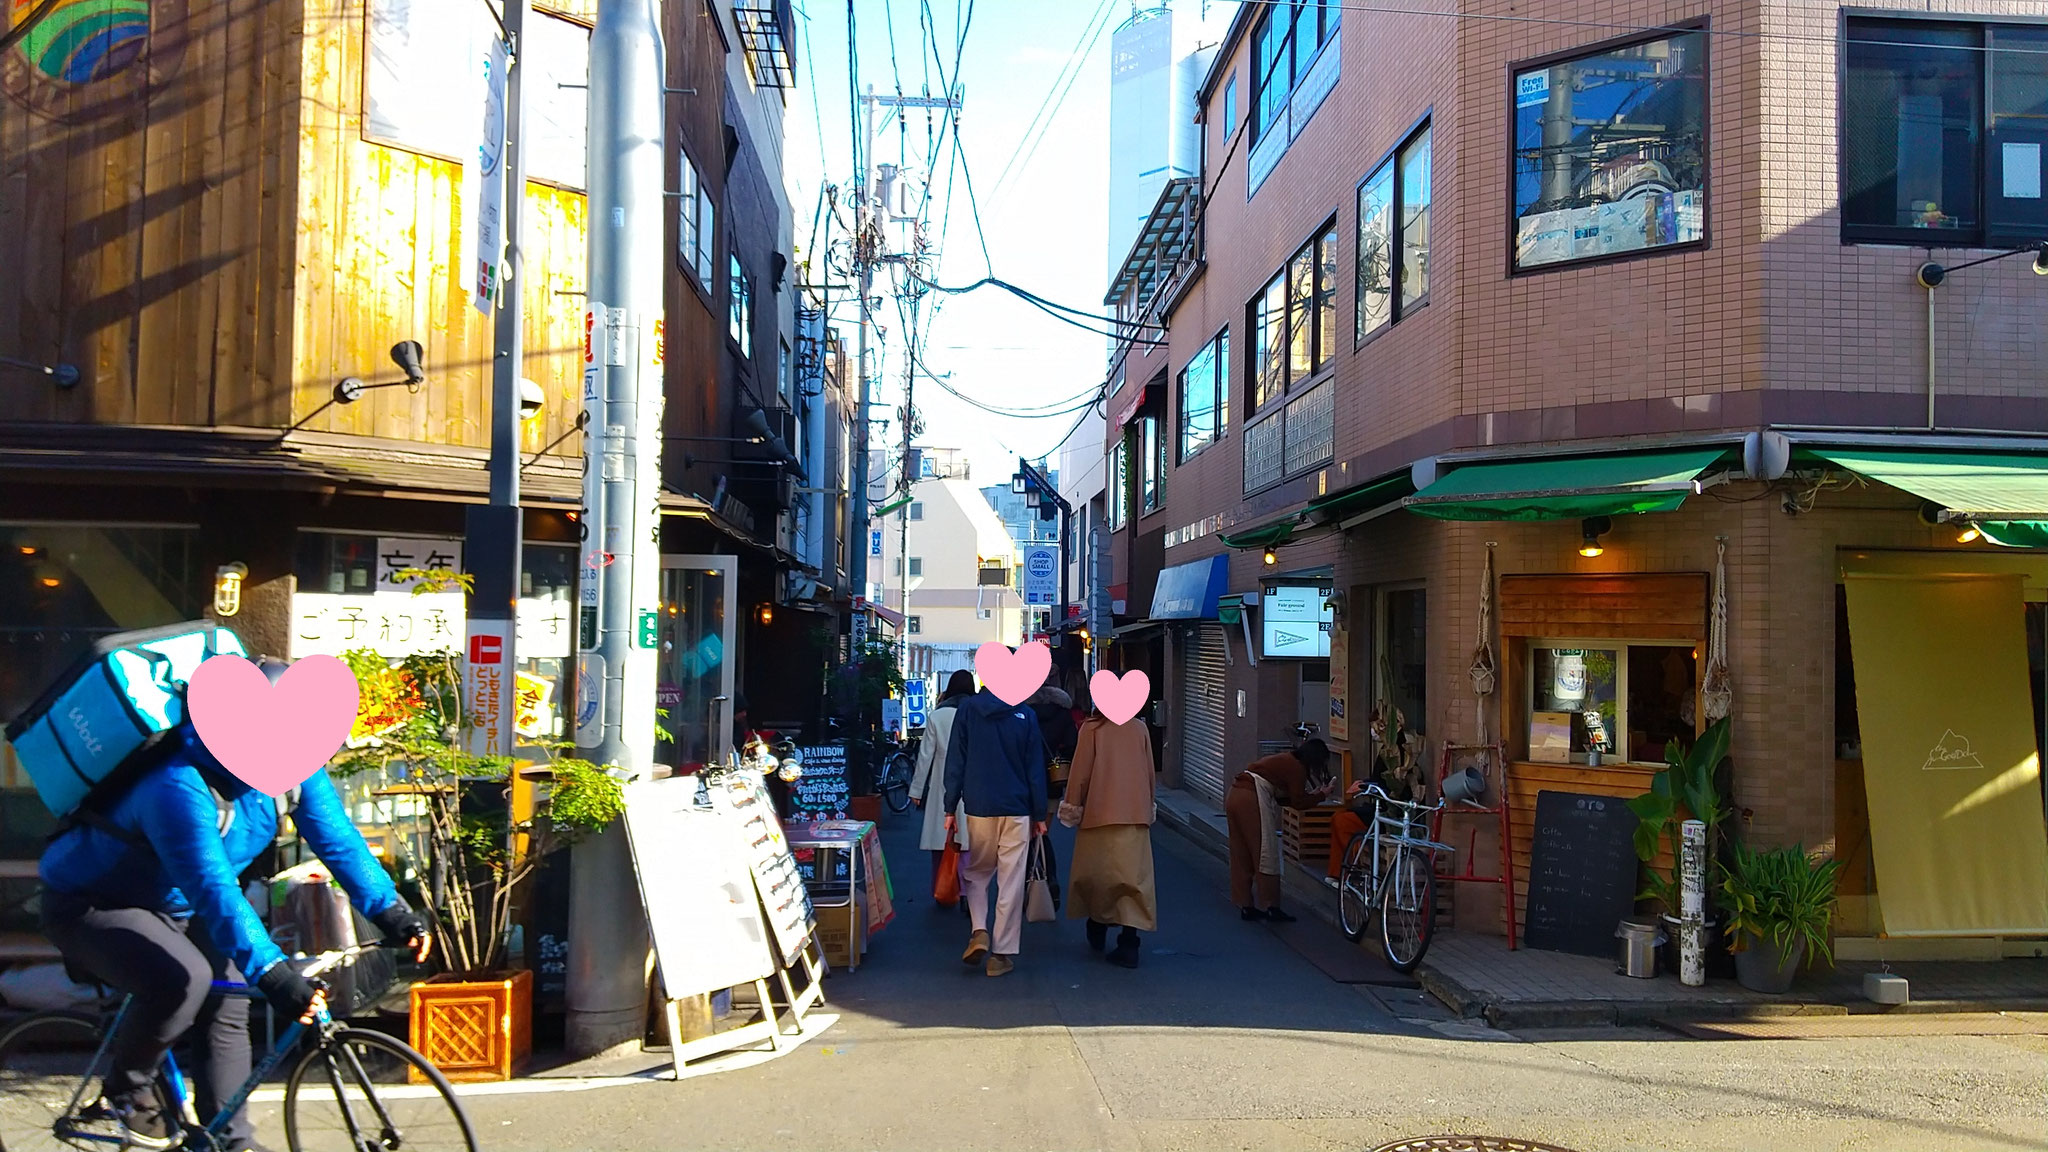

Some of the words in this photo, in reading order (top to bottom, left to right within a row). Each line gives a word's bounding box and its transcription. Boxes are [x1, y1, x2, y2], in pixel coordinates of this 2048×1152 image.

[1522, 76, 1543, 86] Free
[1522, 83, 1543, 93] Wi-Fi
[872, 531, 881, 555] MUD
[658, 693, 681, 703] PEN
[908, 681, 925, 727] MUD
[804, 747, 844, 757] RAINBOW
